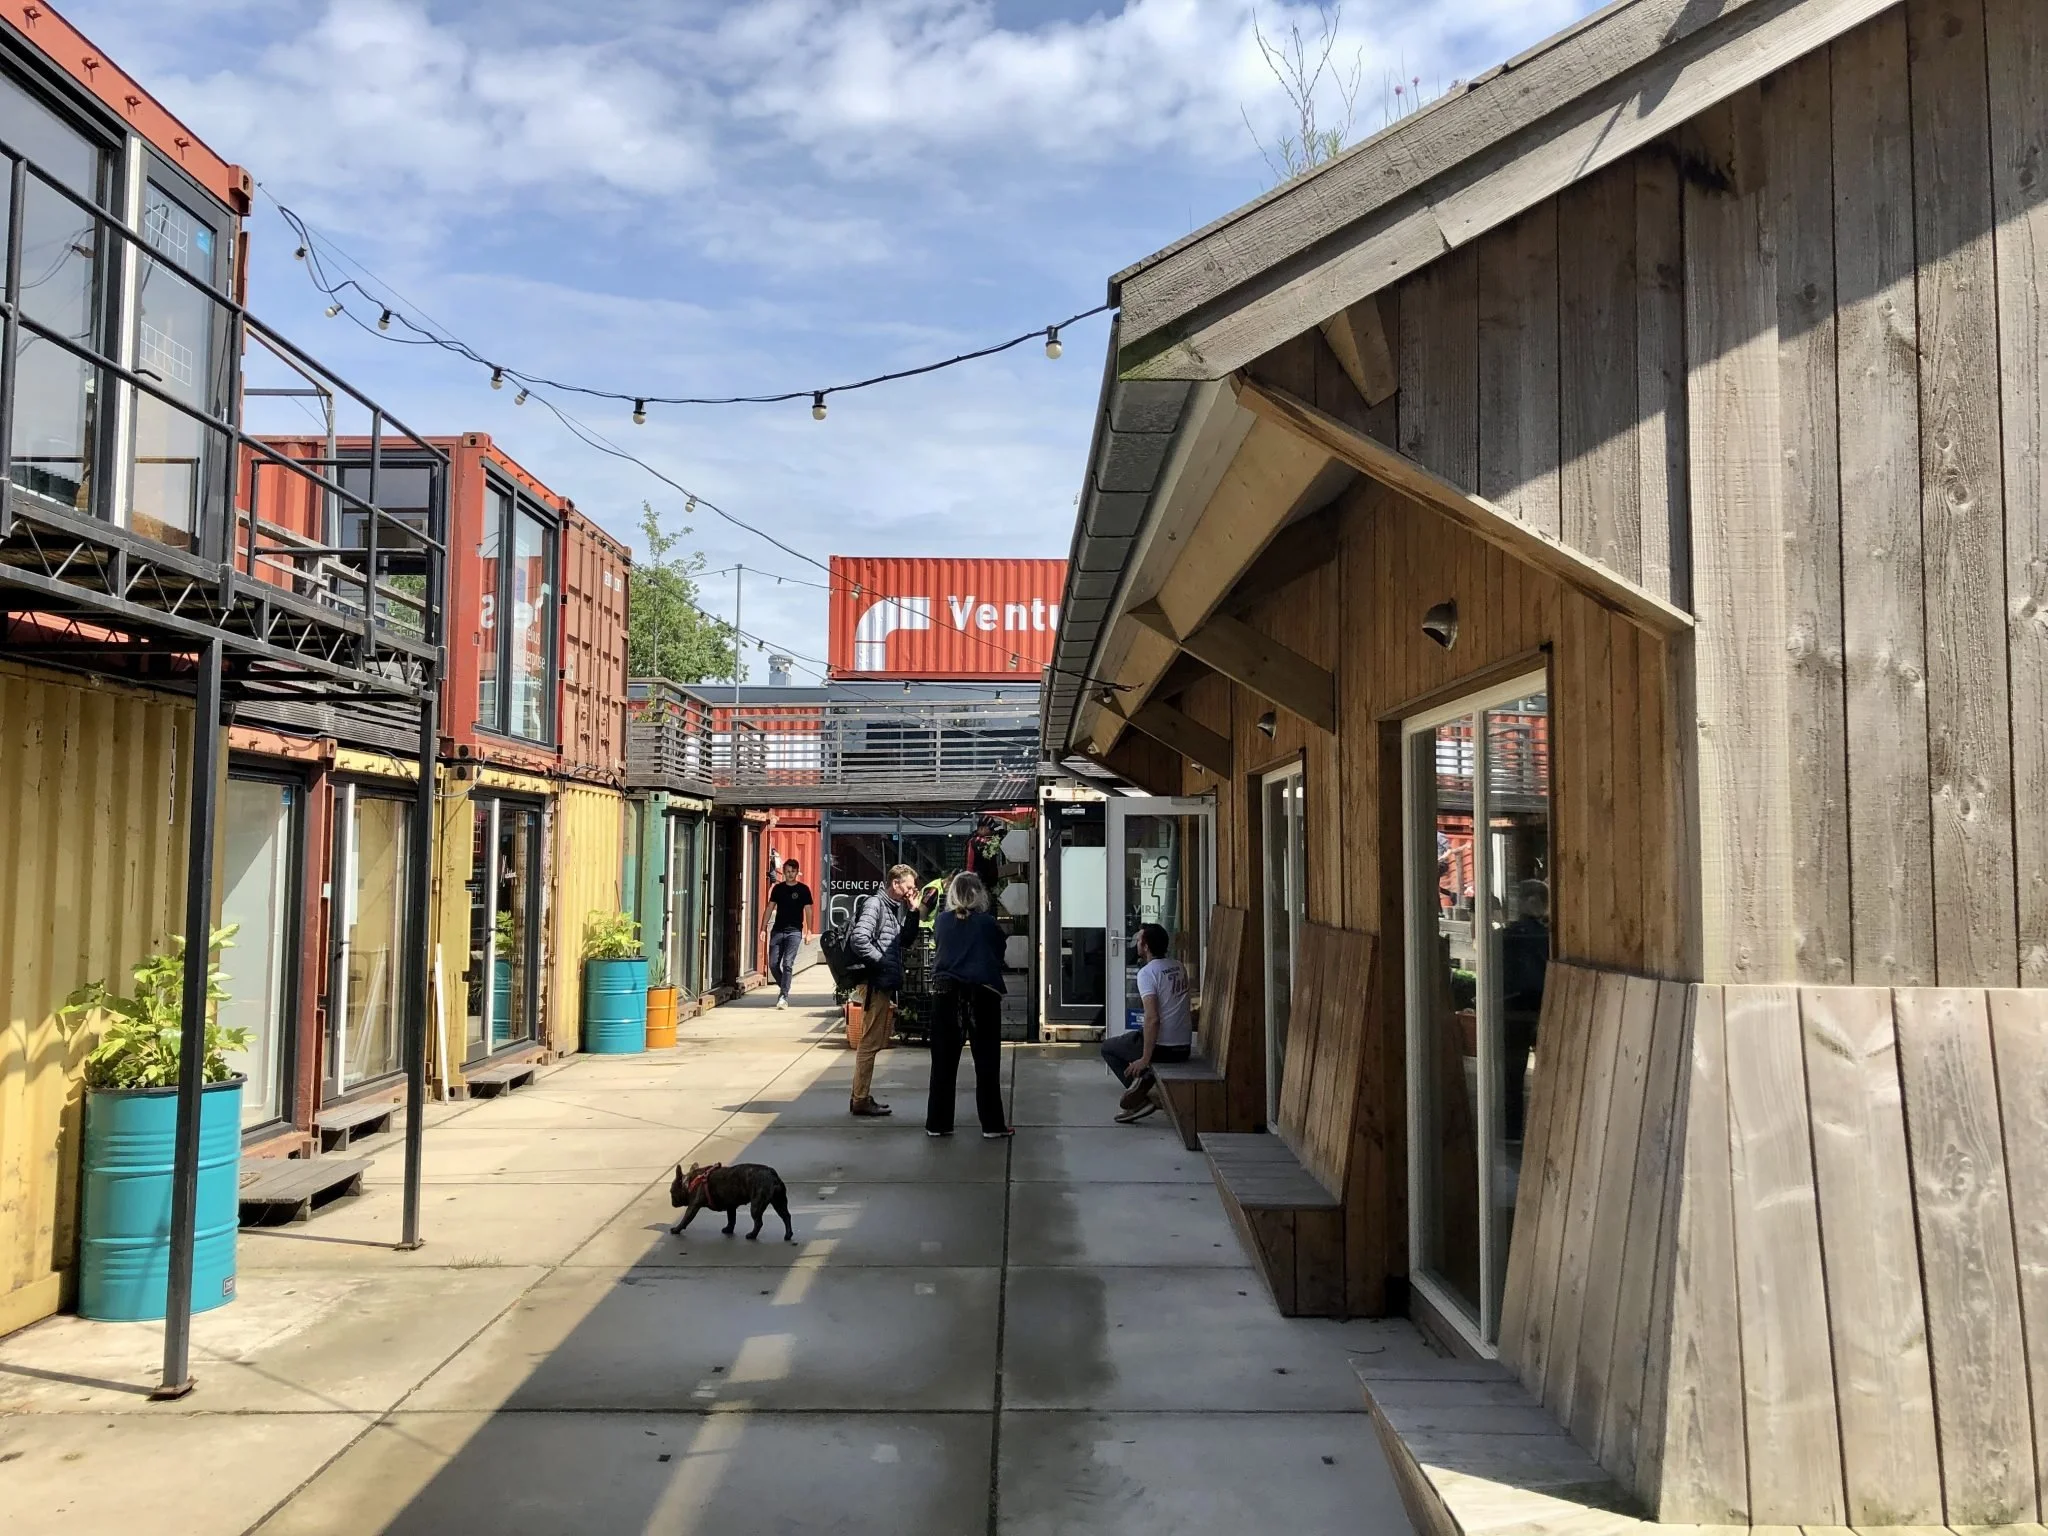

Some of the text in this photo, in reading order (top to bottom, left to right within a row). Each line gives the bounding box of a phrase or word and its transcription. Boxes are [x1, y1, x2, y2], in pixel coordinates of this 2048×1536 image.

[830, 880, 886, 890] SCIENCE PA
[1133, 877, 1153, 887] THE
